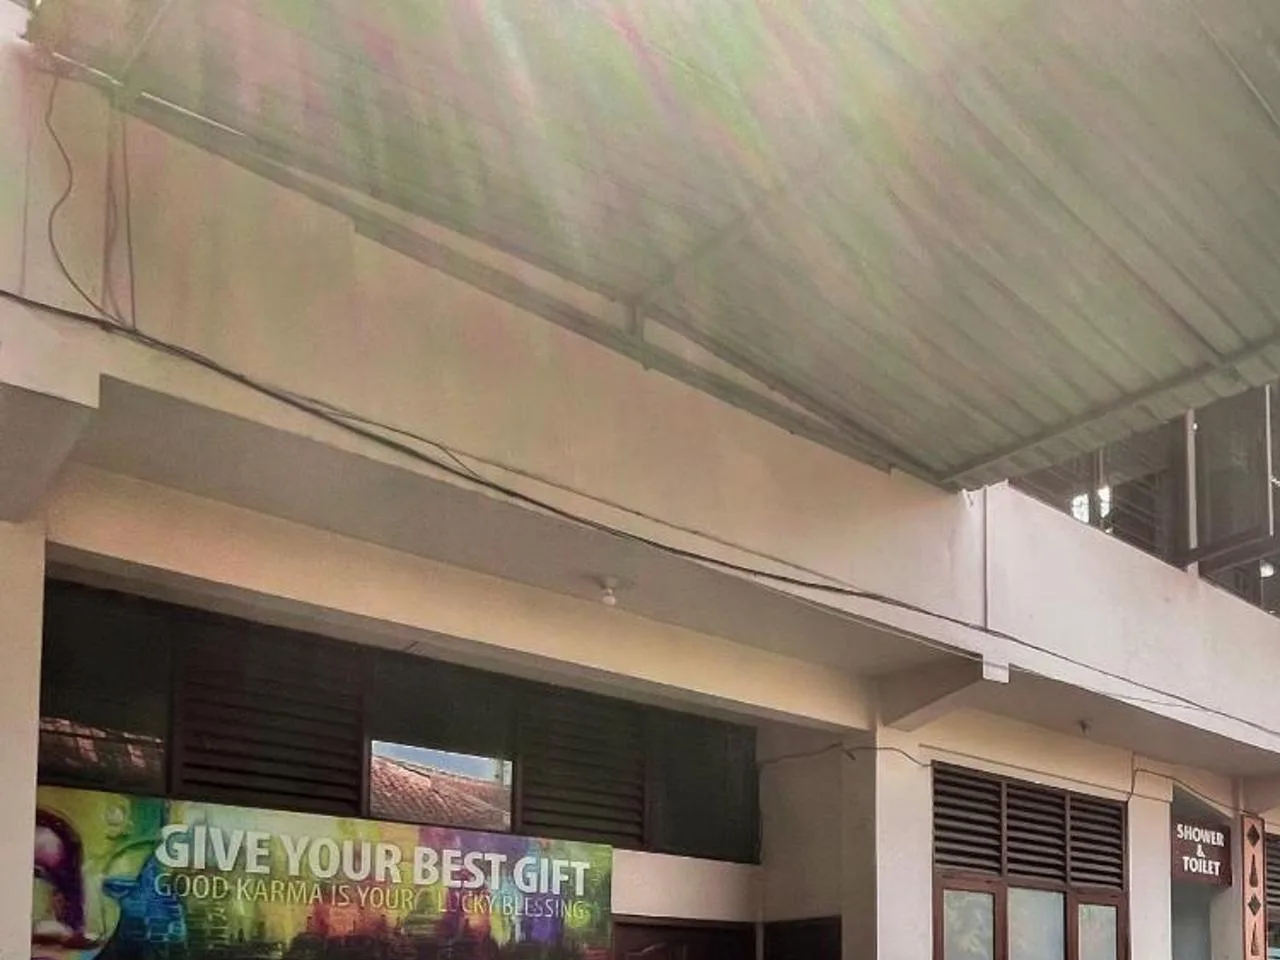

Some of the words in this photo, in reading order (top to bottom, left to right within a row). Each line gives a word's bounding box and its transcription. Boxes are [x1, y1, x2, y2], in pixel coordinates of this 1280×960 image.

[1176, 823, 1225, 848] SHOWER
[155, 824, 271, 874] GIVE
[279, 834, 402, 884] YOUR
[413, 846, 507, 890] BEST
[513, 856, 590, 897] GIFT
[1196, 843, 1206, 858] &
[1182, 856, 1221, 877] TOILET
[154, 872, 229, 900] GOOD
[236, 878, 324, 906] KARMA
[331, 884, 351, 907] IS
[358, 886, 415, 911] YOUR
[502, 895, 585, 920] BLESSING
